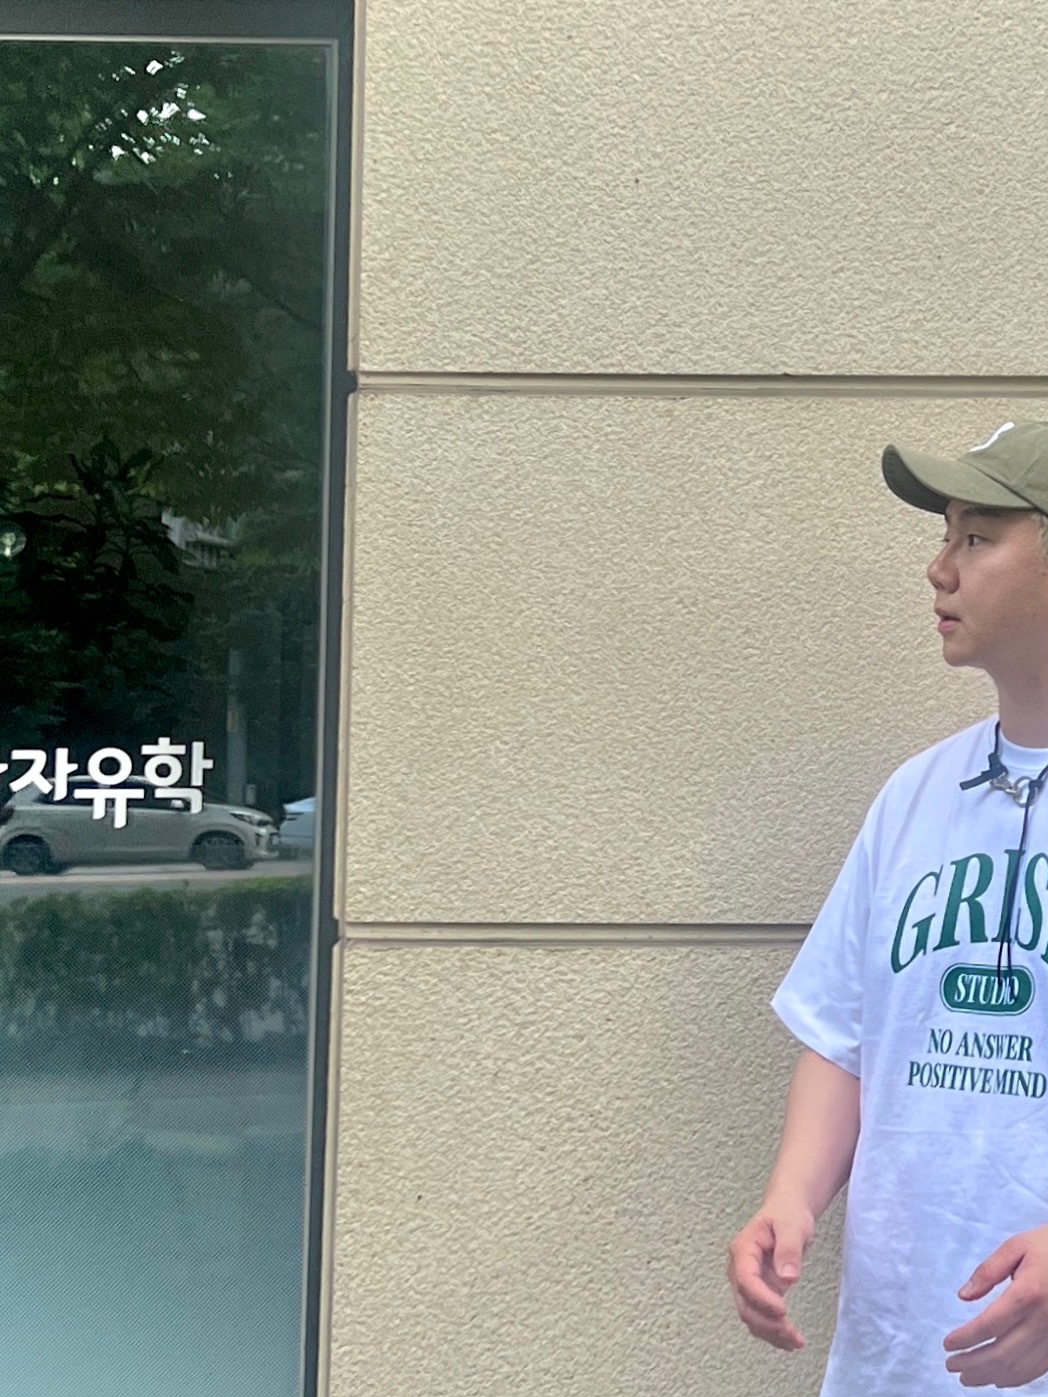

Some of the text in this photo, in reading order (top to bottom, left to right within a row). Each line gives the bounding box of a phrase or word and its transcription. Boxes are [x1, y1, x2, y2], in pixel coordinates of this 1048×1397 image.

[0, 736, 214, 829] 자유학
[926, 1028, 1033, 1062] NO ANSWER
